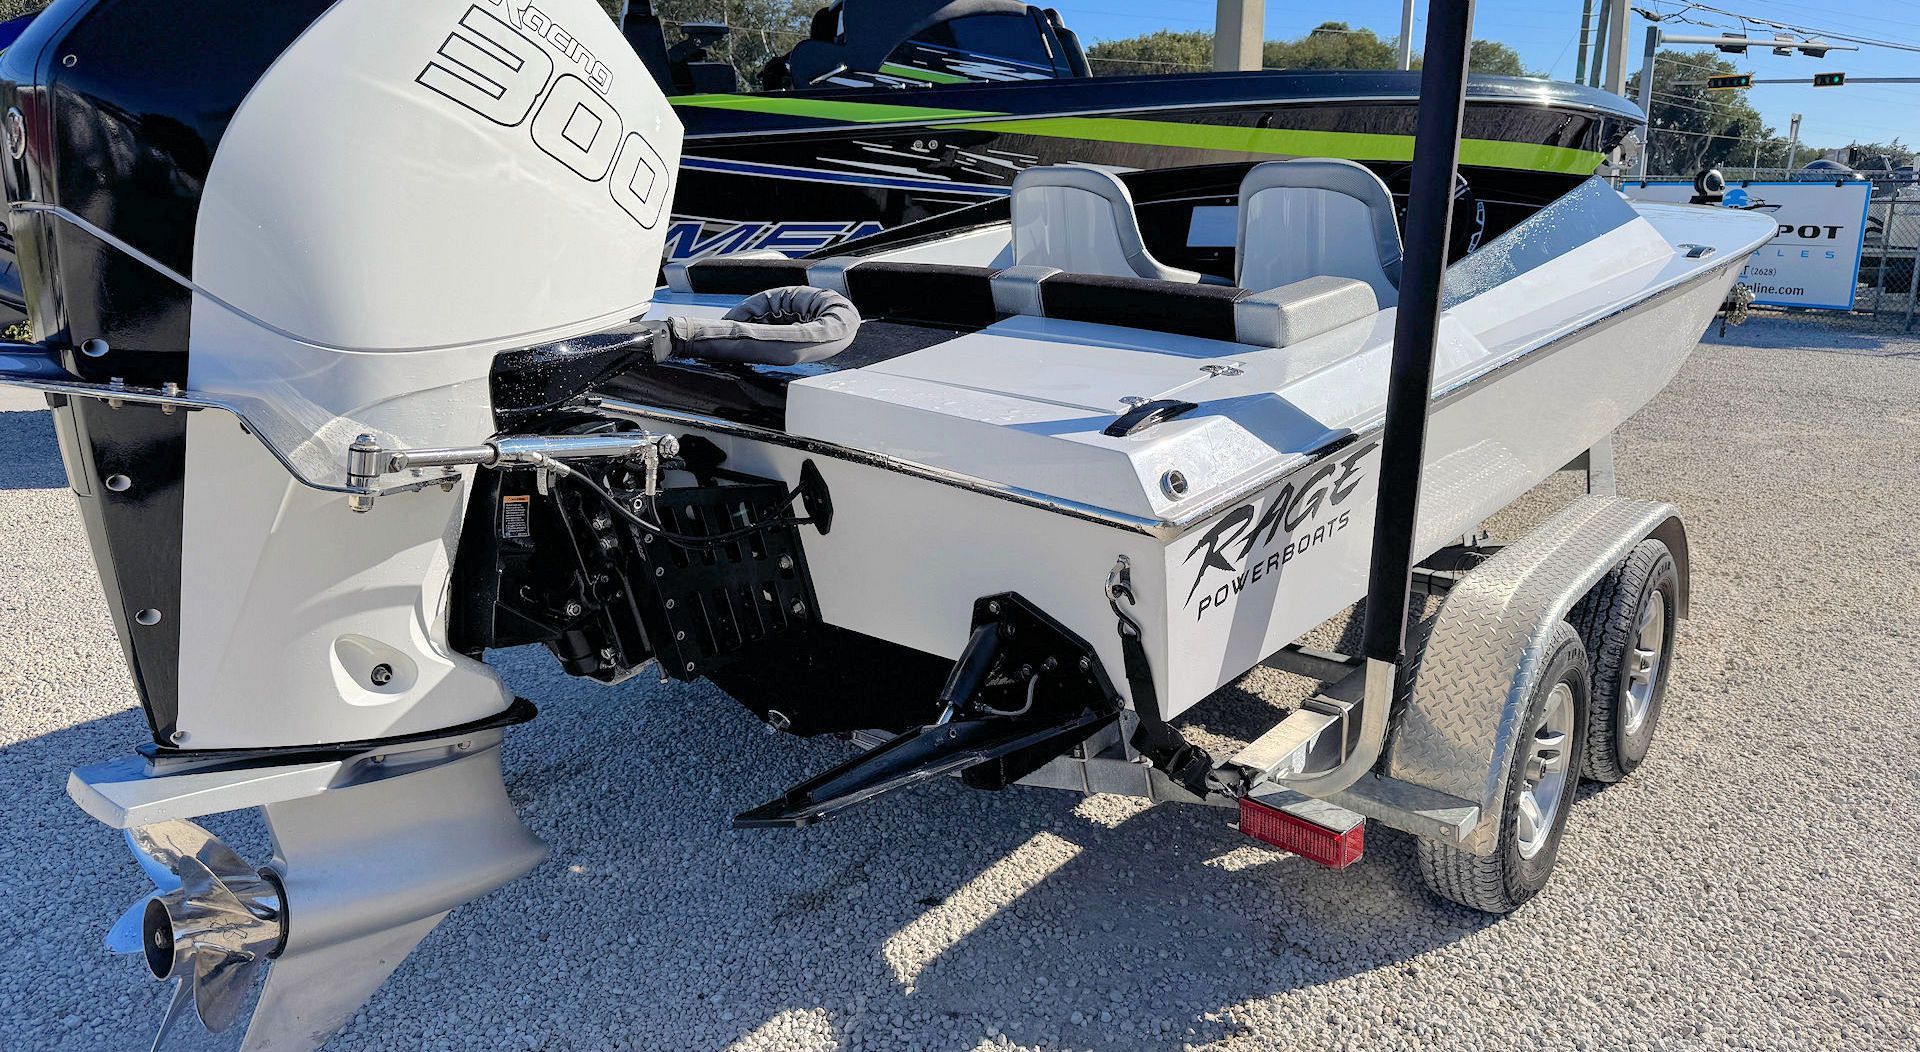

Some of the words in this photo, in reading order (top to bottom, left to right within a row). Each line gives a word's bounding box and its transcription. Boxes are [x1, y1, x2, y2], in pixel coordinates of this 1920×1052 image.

[414, 3, 670, 230] 300
[1751, 267, 1777, 277] (2628)
[1775, 224, 1844, 239] POT
[1181, 441, 1381, 610] RAGE
[1197, 509, 1351, 623] POWERBOATS
